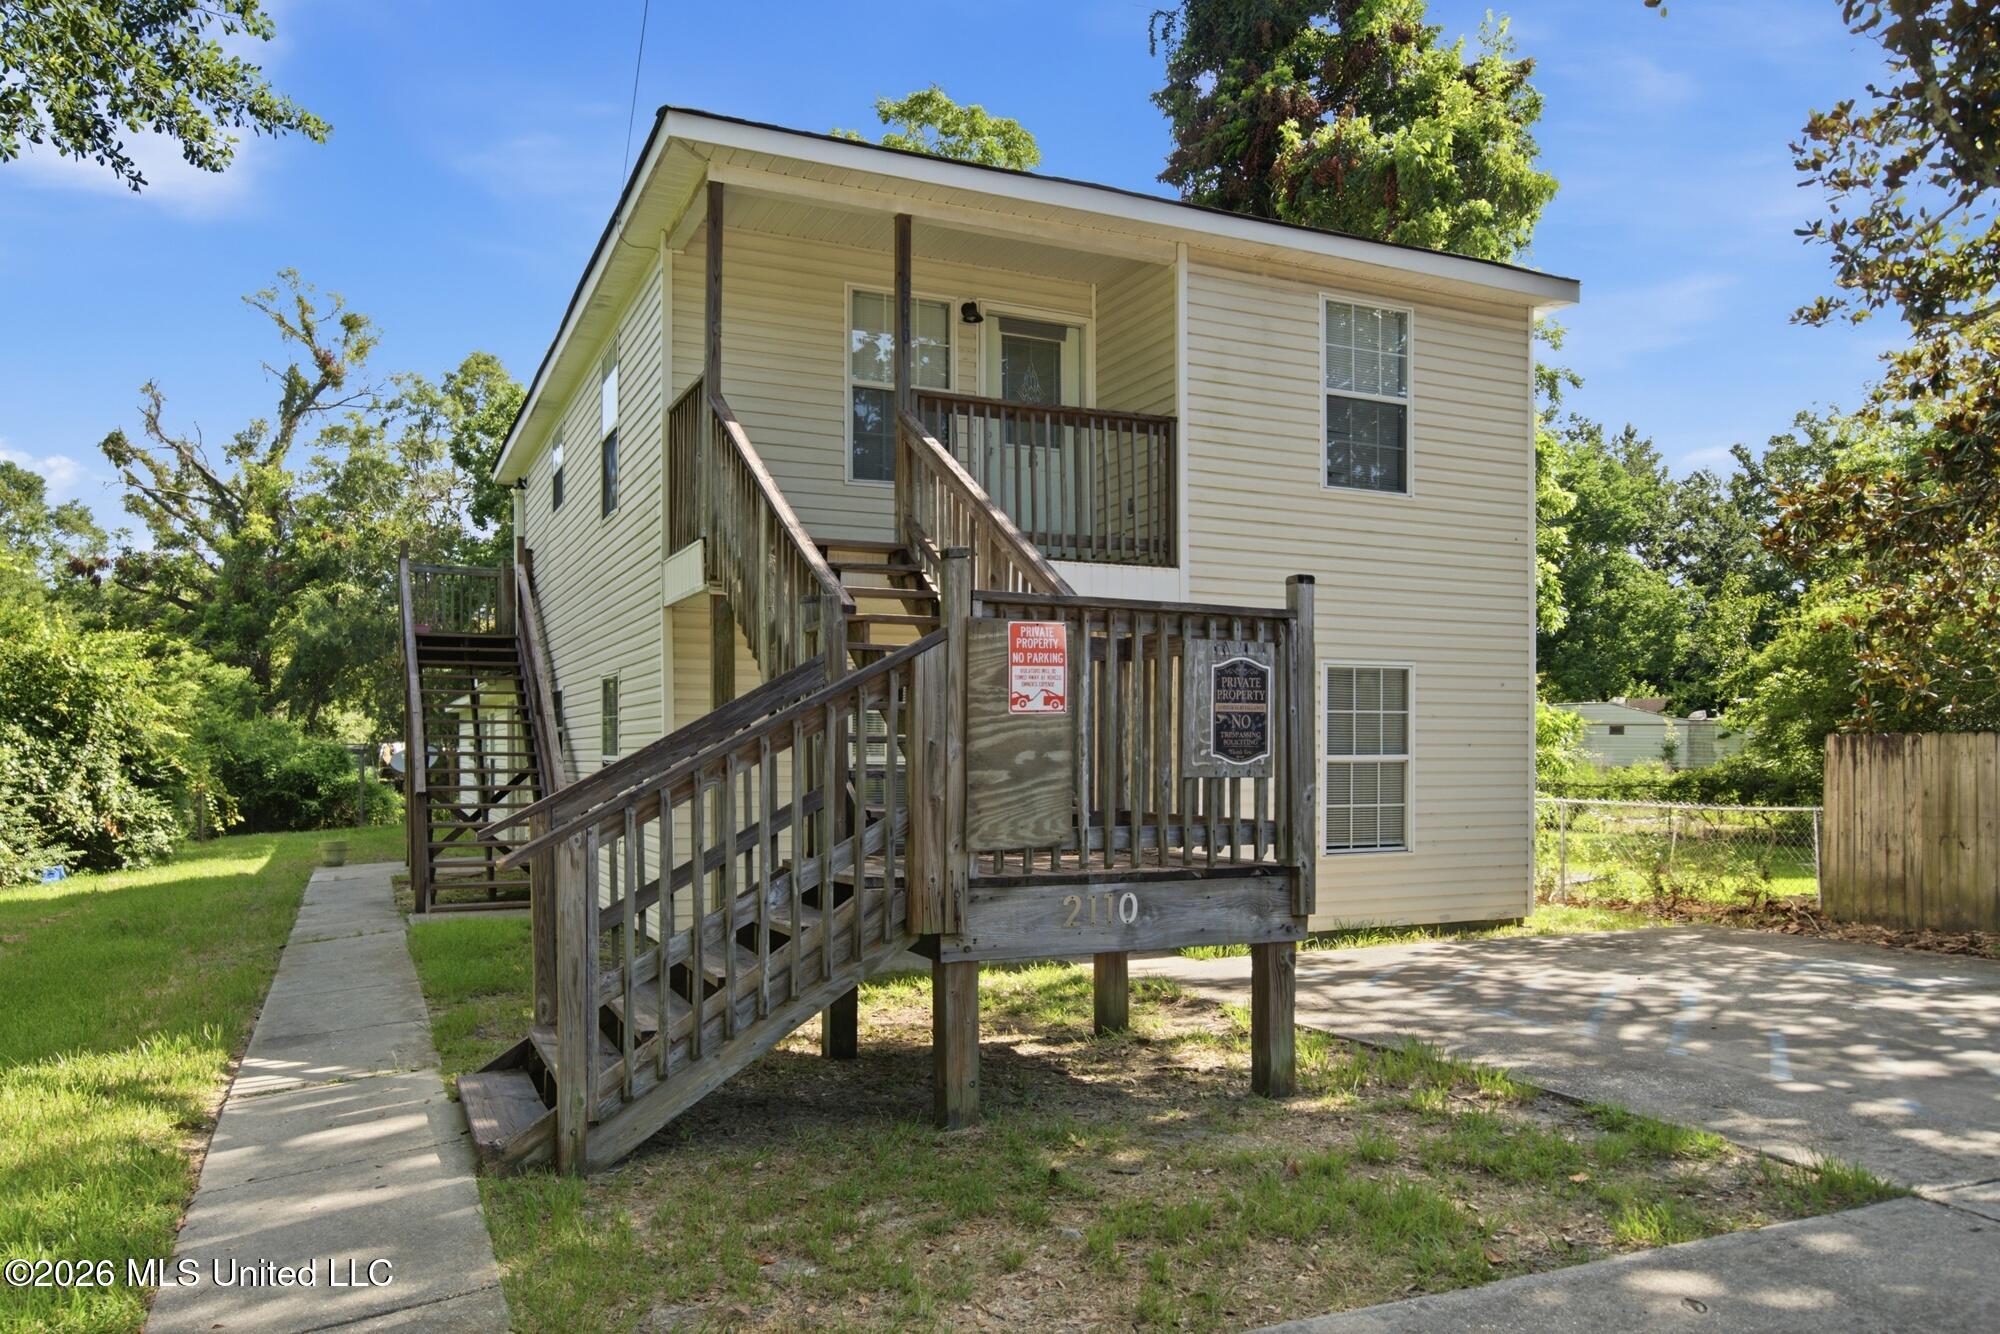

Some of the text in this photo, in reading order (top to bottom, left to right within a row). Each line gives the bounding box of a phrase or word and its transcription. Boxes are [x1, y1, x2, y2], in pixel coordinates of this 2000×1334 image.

[1020, 626, 1054, 638] PRIVATE
[1016, 638, 1058, 649] PROPERTY
[1012, 652, 1064, 664] NO PARKING
[1221, 677, 1262, 688] PRIVATE
[1217, 690, 1266, 701] PROPERTY
[1231, 714, 1252, 729] NO
[1063, 892, 1138, 928] 2110
